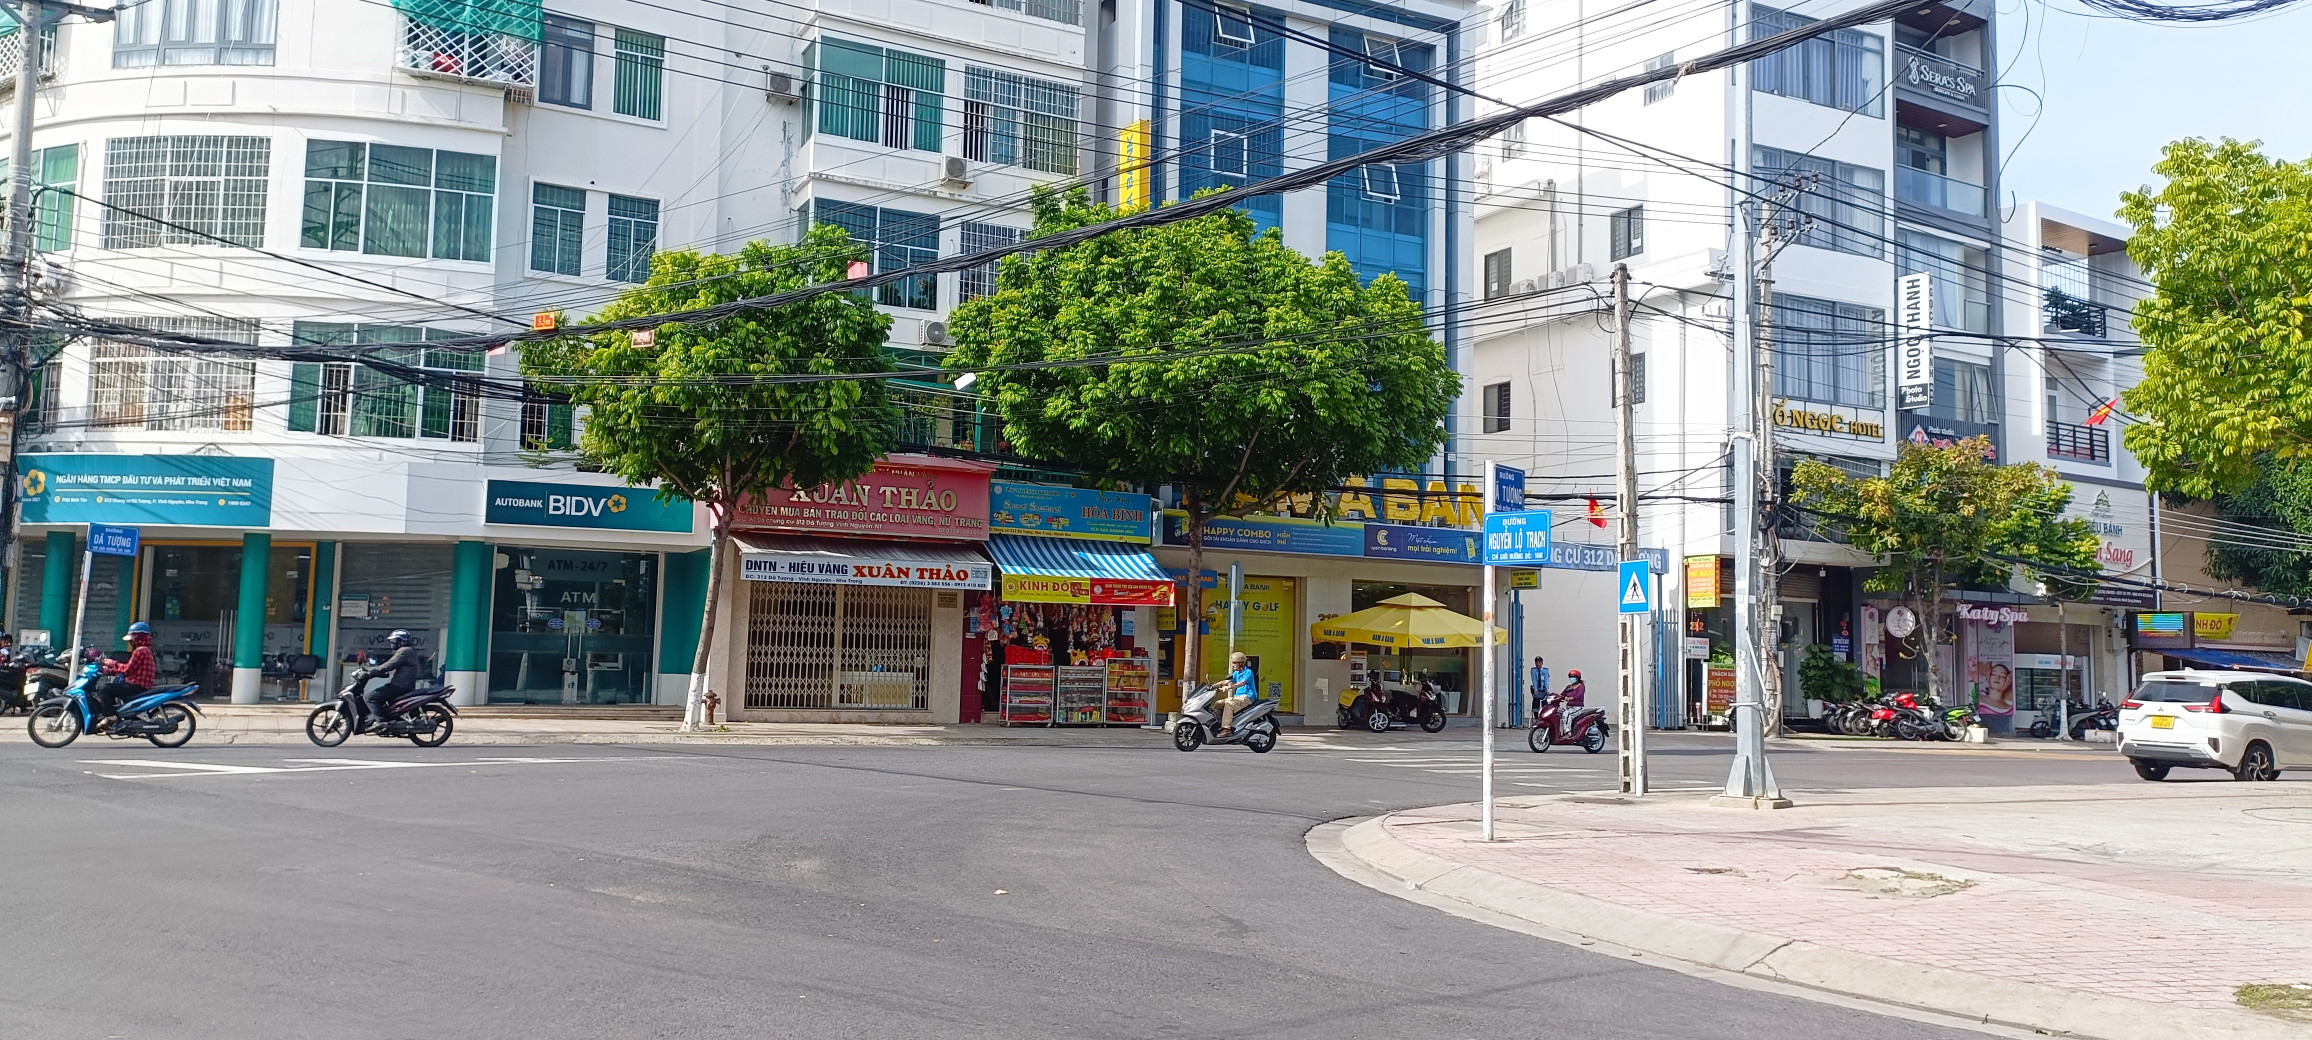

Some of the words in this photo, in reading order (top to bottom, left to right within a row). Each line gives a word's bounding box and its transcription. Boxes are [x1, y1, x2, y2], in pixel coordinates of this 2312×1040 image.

[1956, 76, 1976, 97] SPA
[1900, 386, 1922, 396] Photo
[1905, 395, 1928, 404] Studio
[1790, 409, 1844, 436] NGỌC
[1848, 420, 1883, 438] HOTEL
[78, 474, 98, 484] HÀNG
[100, 476, 120, 484] TMCP
[152, 475, 163, 485] VÀ
[164, 475, 186, 486] PHÁT
[232, 478, 252, 487] NAM
[494, 497, 543, 509] AUTOBANK
[878, 480, 958, 512] THẢO
[1338, 475, 1376, 519] A
[1383, 478, 1484, 526] BAN
[548, 494, 607, 517] BIDV
[780, 507, 800, 517] MUA
[803, 506, 821, 518] BÁN
[825, 509, 848, 520] TRAO
[870, 511, 887, 522] CÁC
[890, 515, 909, 526] LOẠI
[954, 518, 983, 528] TRANG
[1082, 504, 1108, 520] HÒA
[1112, 506, 1143, 522] BÌNH
[1502, 516, 1527, 526] ĐƯỜNG
[1203, 526, 1235, 537] HAPPY
[1238, 528, 1272, 538] COMBO
[2103, 521, 2122, 536] BÁNH
[108, 535, 132, 548] TƯỢNG
[1488, 526, 1512, 550] NGUYỄN
[1515, 528, 1523, 552] LỘ
[1526, 530, 1546, 551] TRẠCH
[1407, 545, 1419, 553] mọi
[1564, 546, 1582, 564] CƯ
[1584, 550, 1604, 566] 312
[2106, 541, 2134, 568] Sang
[548, 560, 608, 572] ATM-24/7
[746, 560, 777, 571] DNTN
[788, 560, 815, 575] HIỆU
[818, 562, 848, 574] VÀNG
[853, 562, 911, 579] XUÂN
[916, 564, 969, 581] THẢO
[1020, 580, 1048, 591] KINH
[1052, 580, 1070, 592] ĐÔ
[561, 591, 596, 604] ATM
[1956, 603, 1999, 625] Katy
[1999, 607, 2029, 626] Spa
[2209, 617, 2222, 630] ĐÔ
[1709, 678, 1720, 686] PHỐ
[1721, 680, 1735, 689] NGỌ
